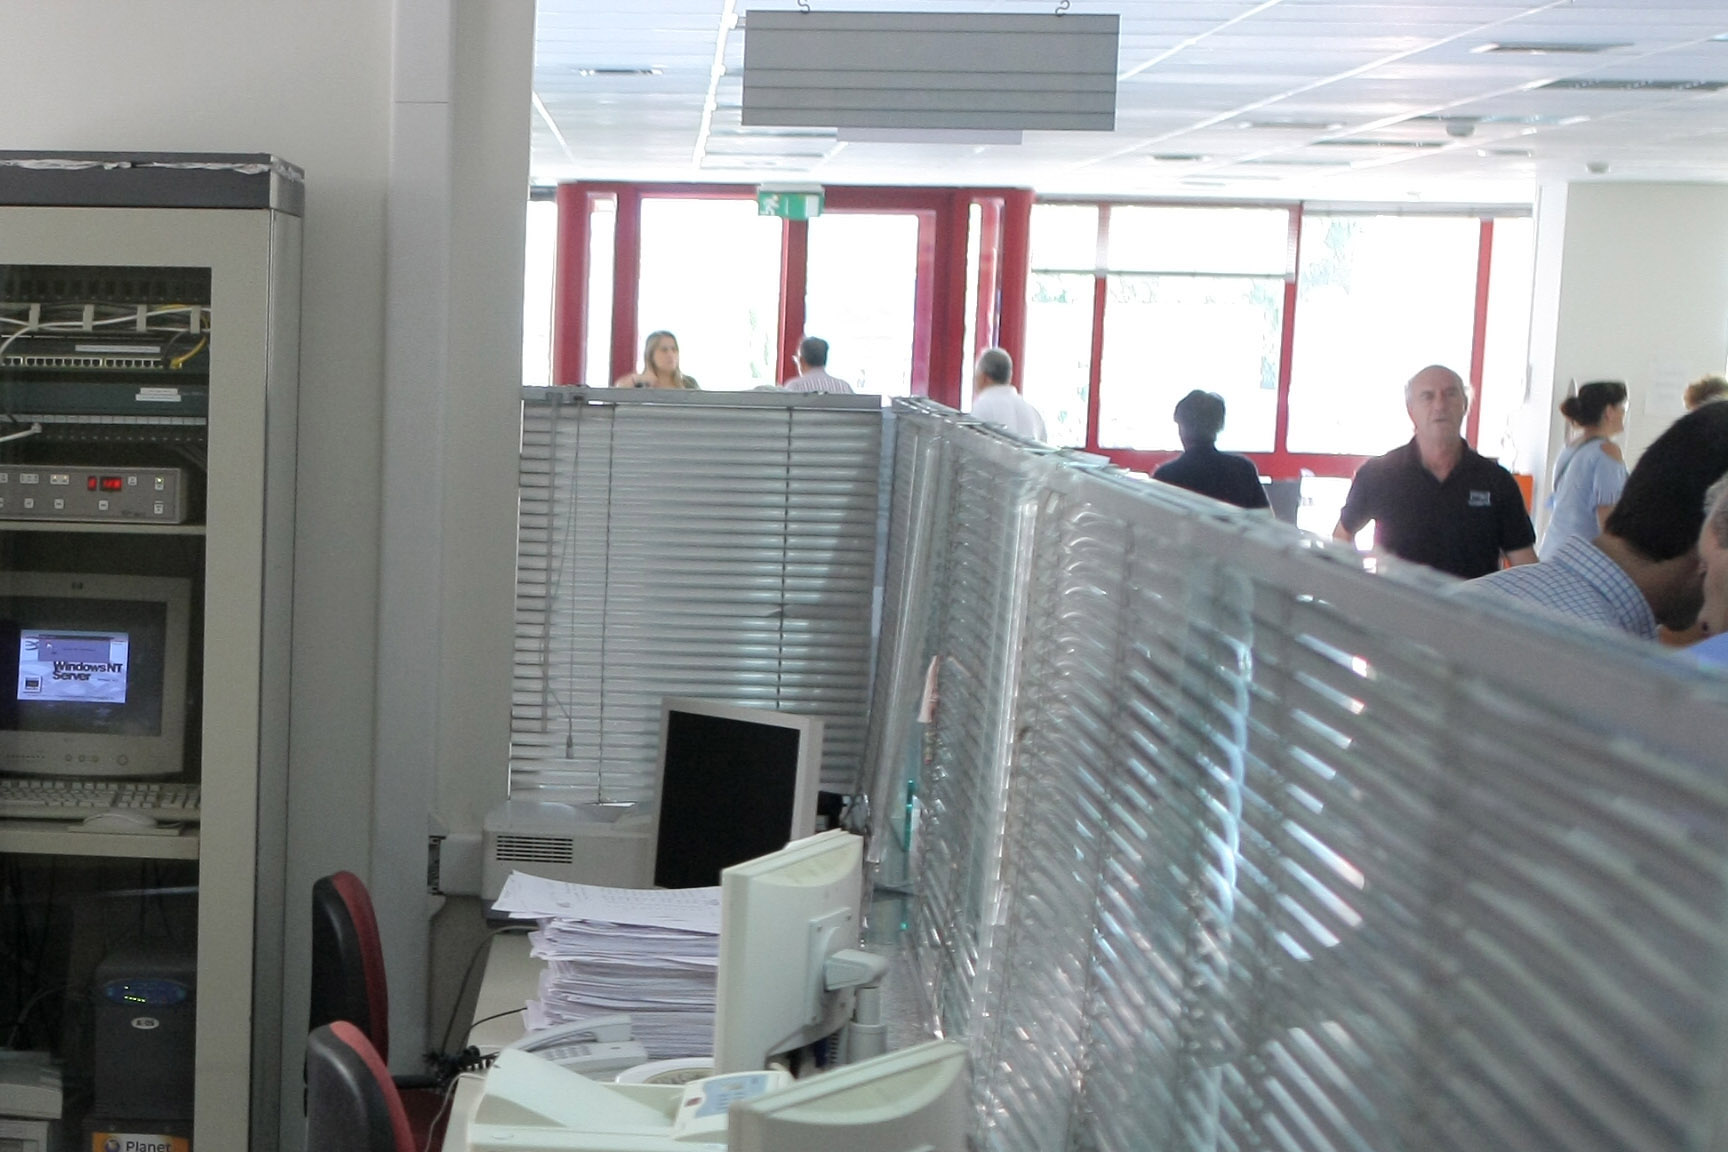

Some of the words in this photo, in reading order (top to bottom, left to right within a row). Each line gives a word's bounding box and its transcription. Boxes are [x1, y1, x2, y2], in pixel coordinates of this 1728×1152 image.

[53, 660, 106, 673] Windows
[107, 663, 124, 673] NT
[53, 671, 91, 681] Server
